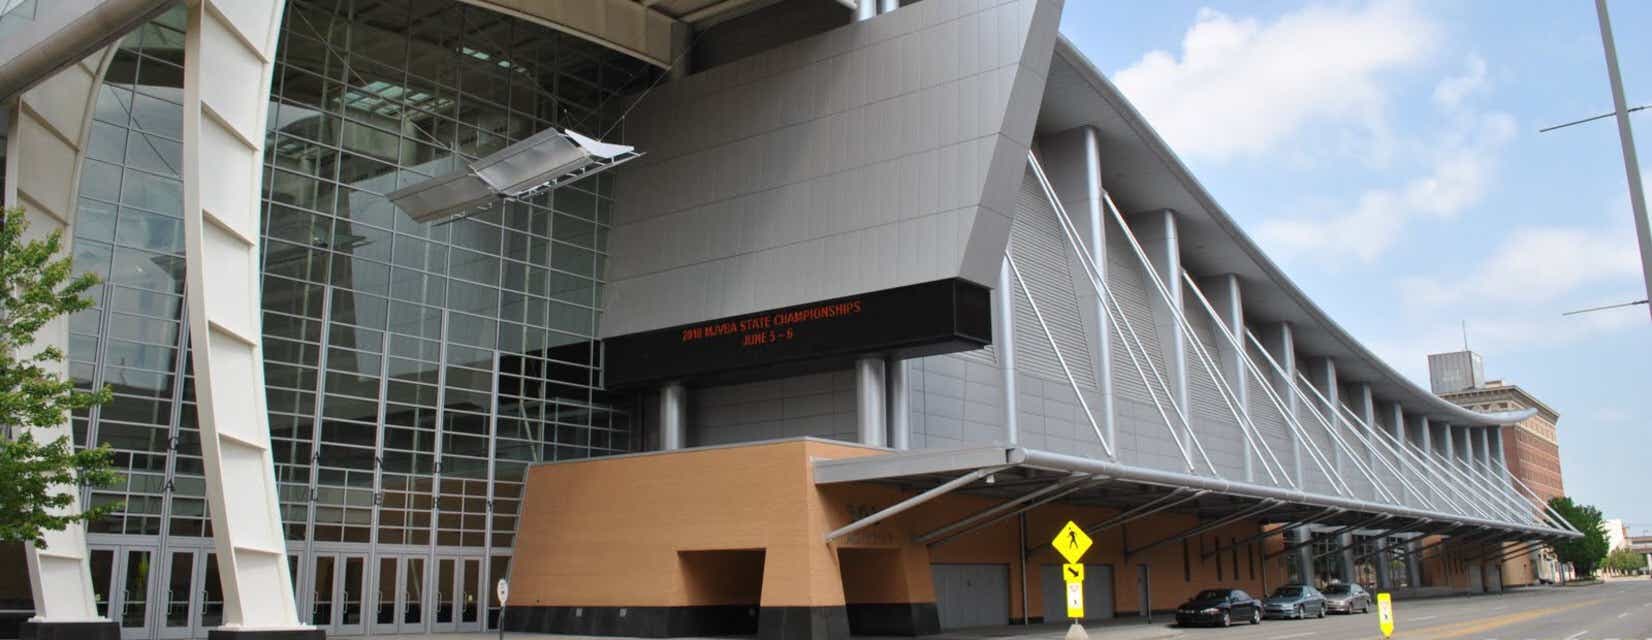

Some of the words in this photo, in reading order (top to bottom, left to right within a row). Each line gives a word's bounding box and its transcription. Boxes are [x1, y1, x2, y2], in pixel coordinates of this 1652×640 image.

[740, 316, 769, 331] STATE
[774, 300, 862, 326] CHAMPIONSHIPS
[744, 331, 768, 345] JUNE
